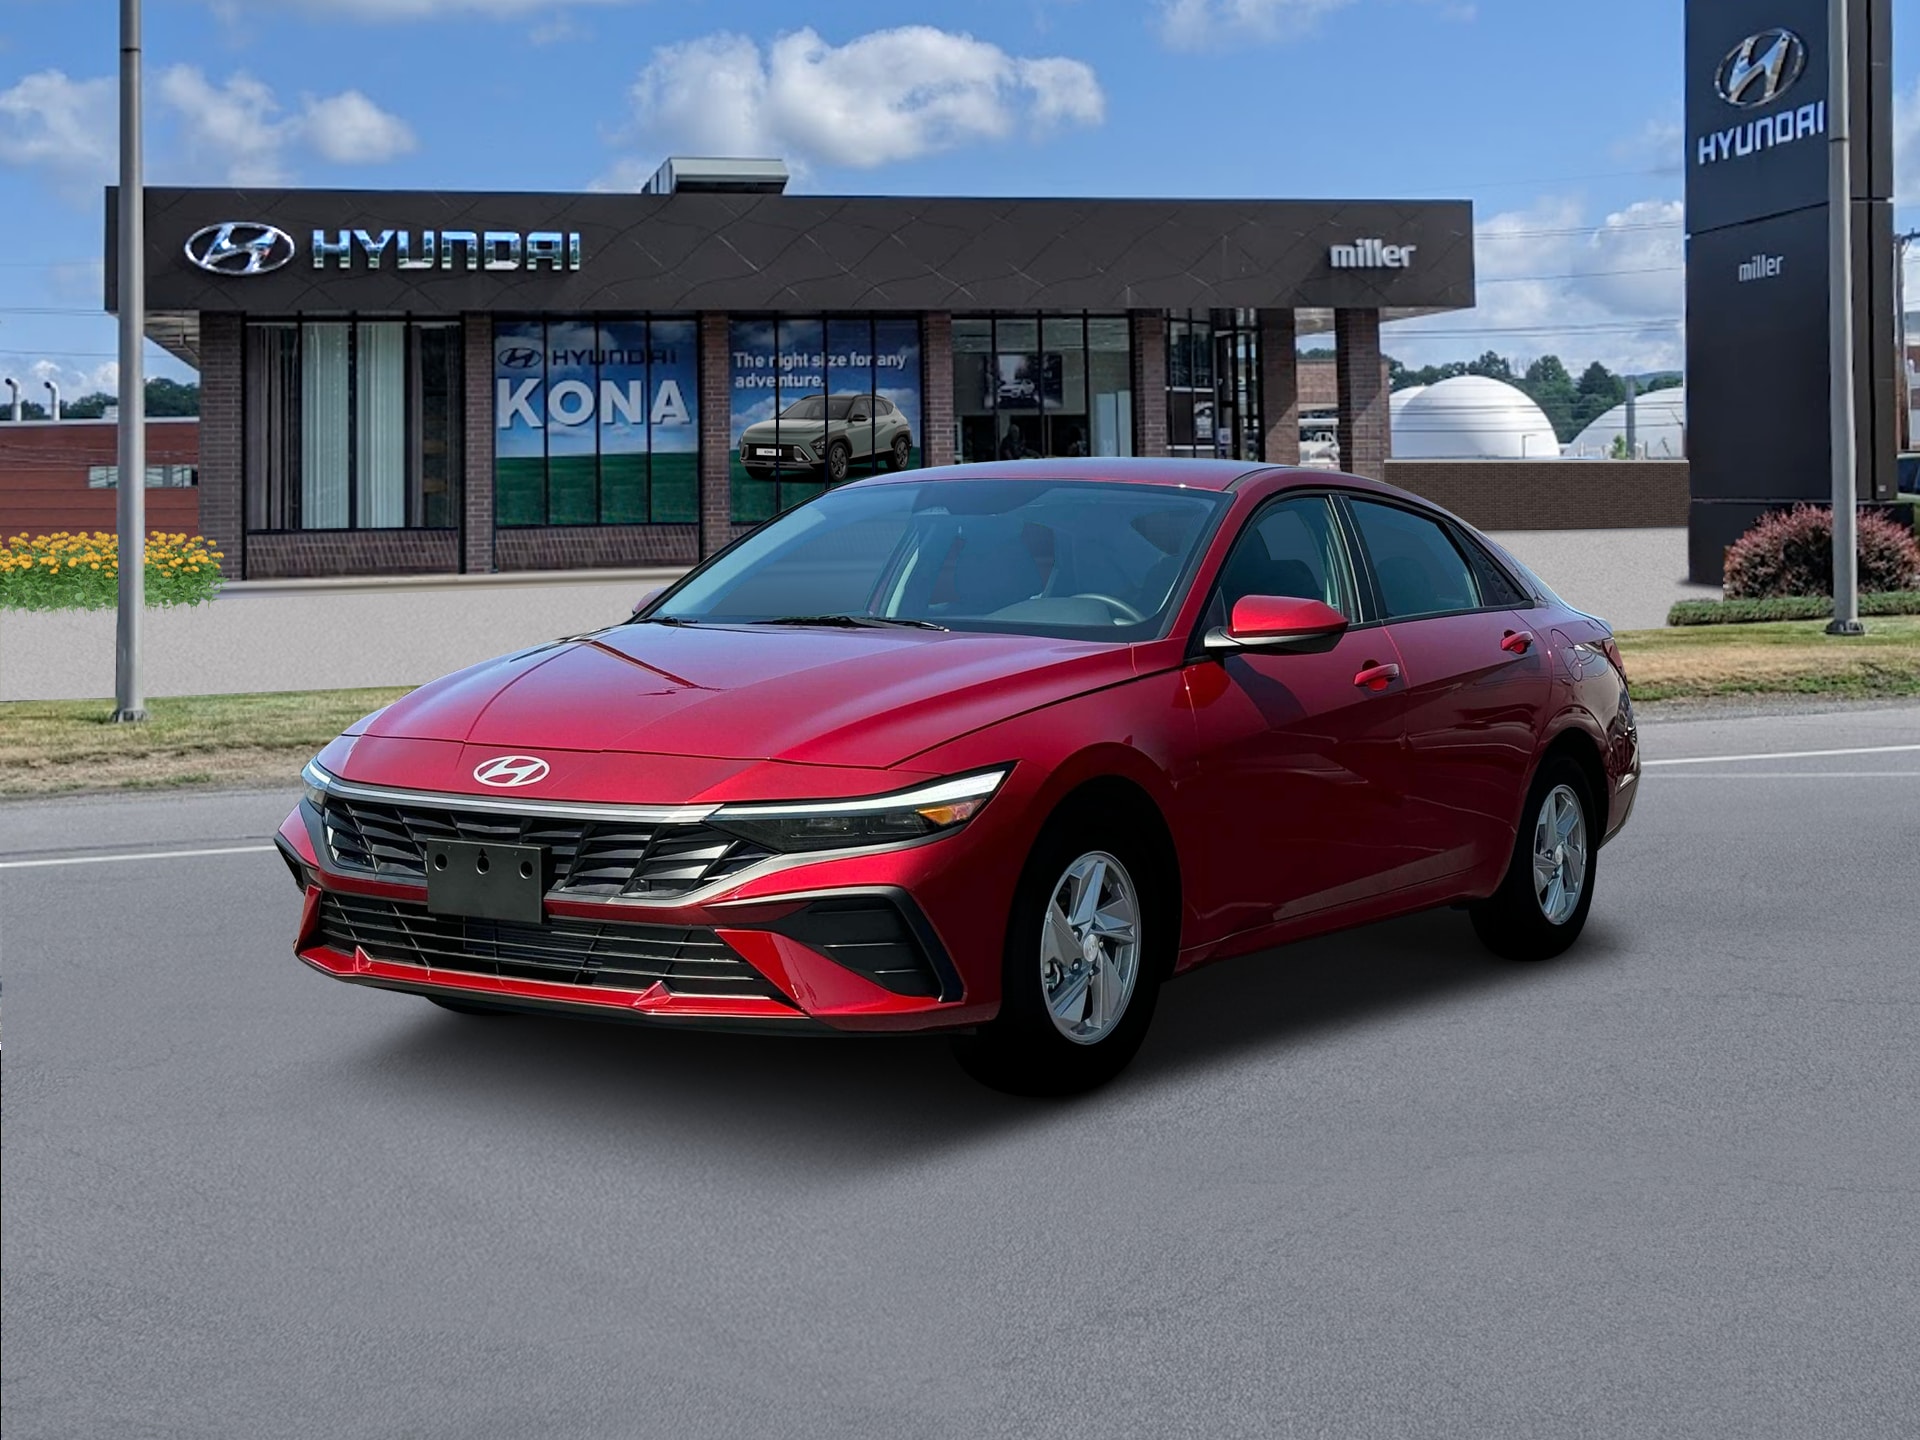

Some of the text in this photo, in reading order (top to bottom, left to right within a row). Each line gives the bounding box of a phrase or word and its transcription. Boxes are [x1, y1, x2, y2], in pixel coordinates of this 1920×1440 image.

[1698, 100, 1825, 165] HYUNDAI
[312, 229, 581, 271] HYUNDAI
[1330, 238, 1417, 268] miller
[1738, 254, 1784, 282] miller
[552, 349, 677, 366] HYUNDAI
[733, 351, 906, 371] The right size for any
[735, 373, 824, 388] adventure.
[497, 377, 690, 428] KONA
